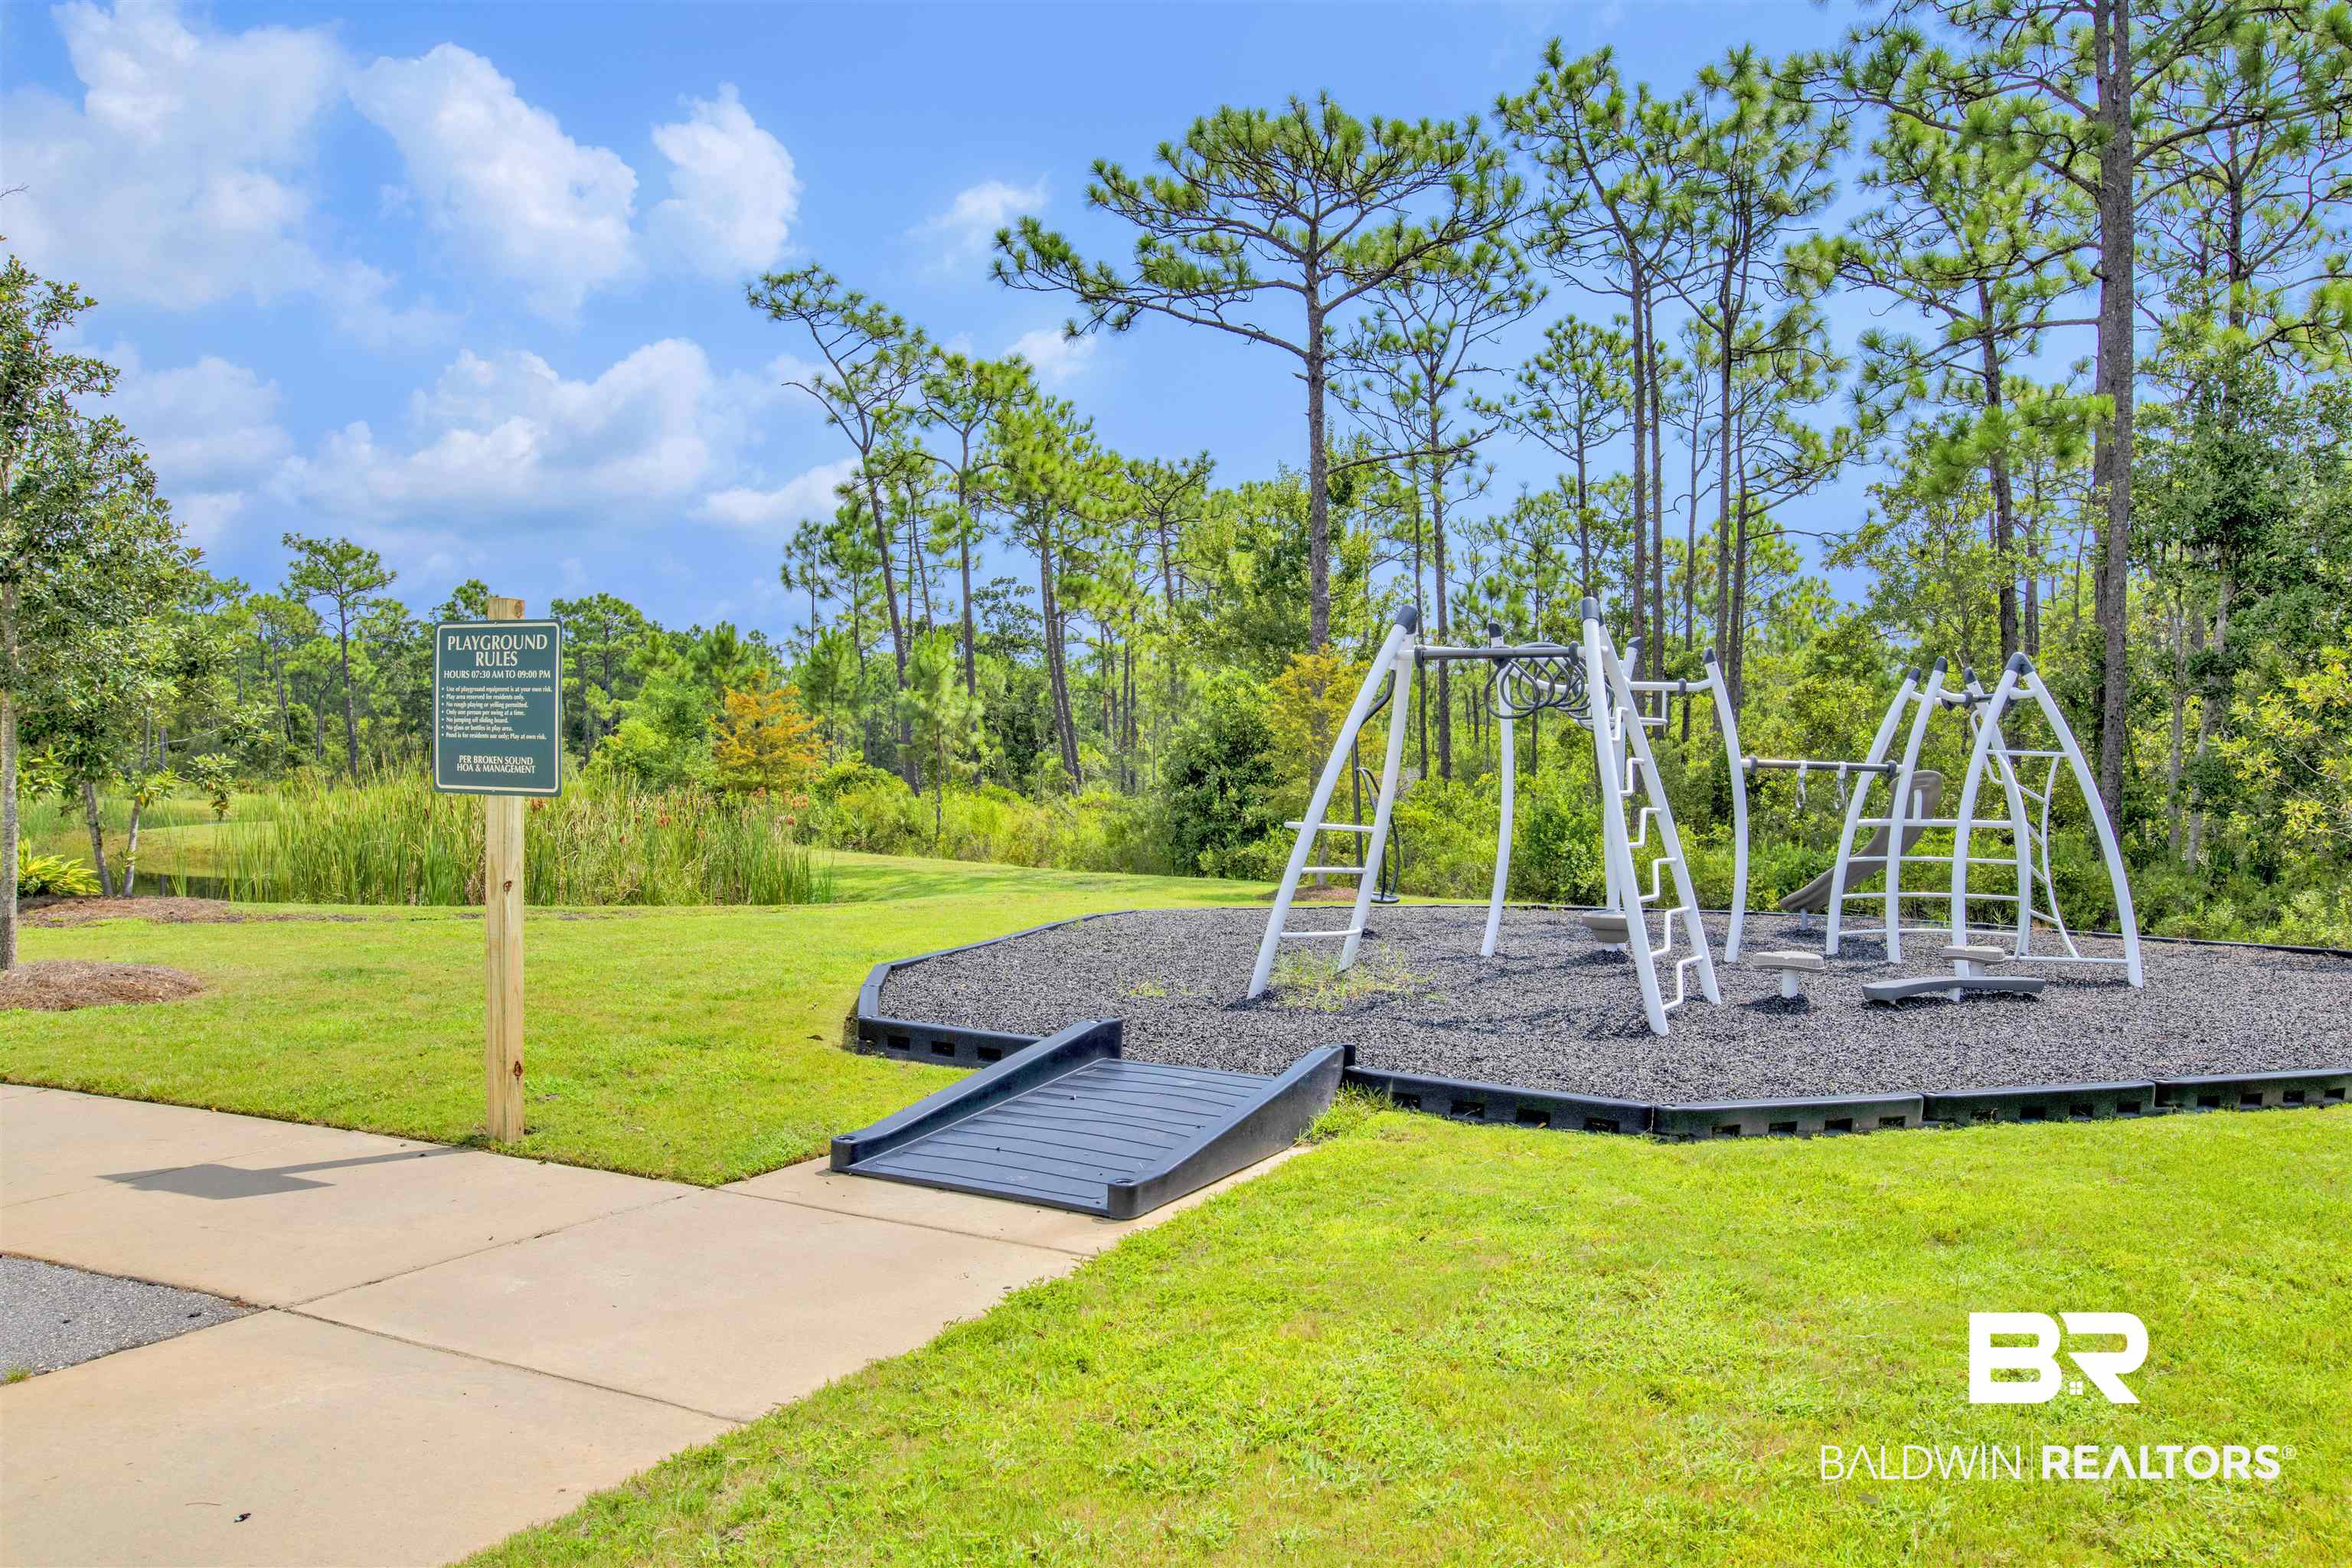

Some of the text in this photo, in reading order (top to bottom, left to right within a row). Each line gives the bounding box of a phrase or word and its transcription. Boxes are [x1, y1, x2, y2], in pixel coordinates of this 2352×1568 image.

[448, 635, 547, 650] PLAYGROUND
[475, 651, 518, 666] RULES
[444, 670, 550, 678] HOURS 07:30 AM TO 09:00 PM
[474, 756, 503, 764] BROKEN
[505, 756, 533, 765] SOUND
[483, 765, 535, 773] MANAGEMENT
